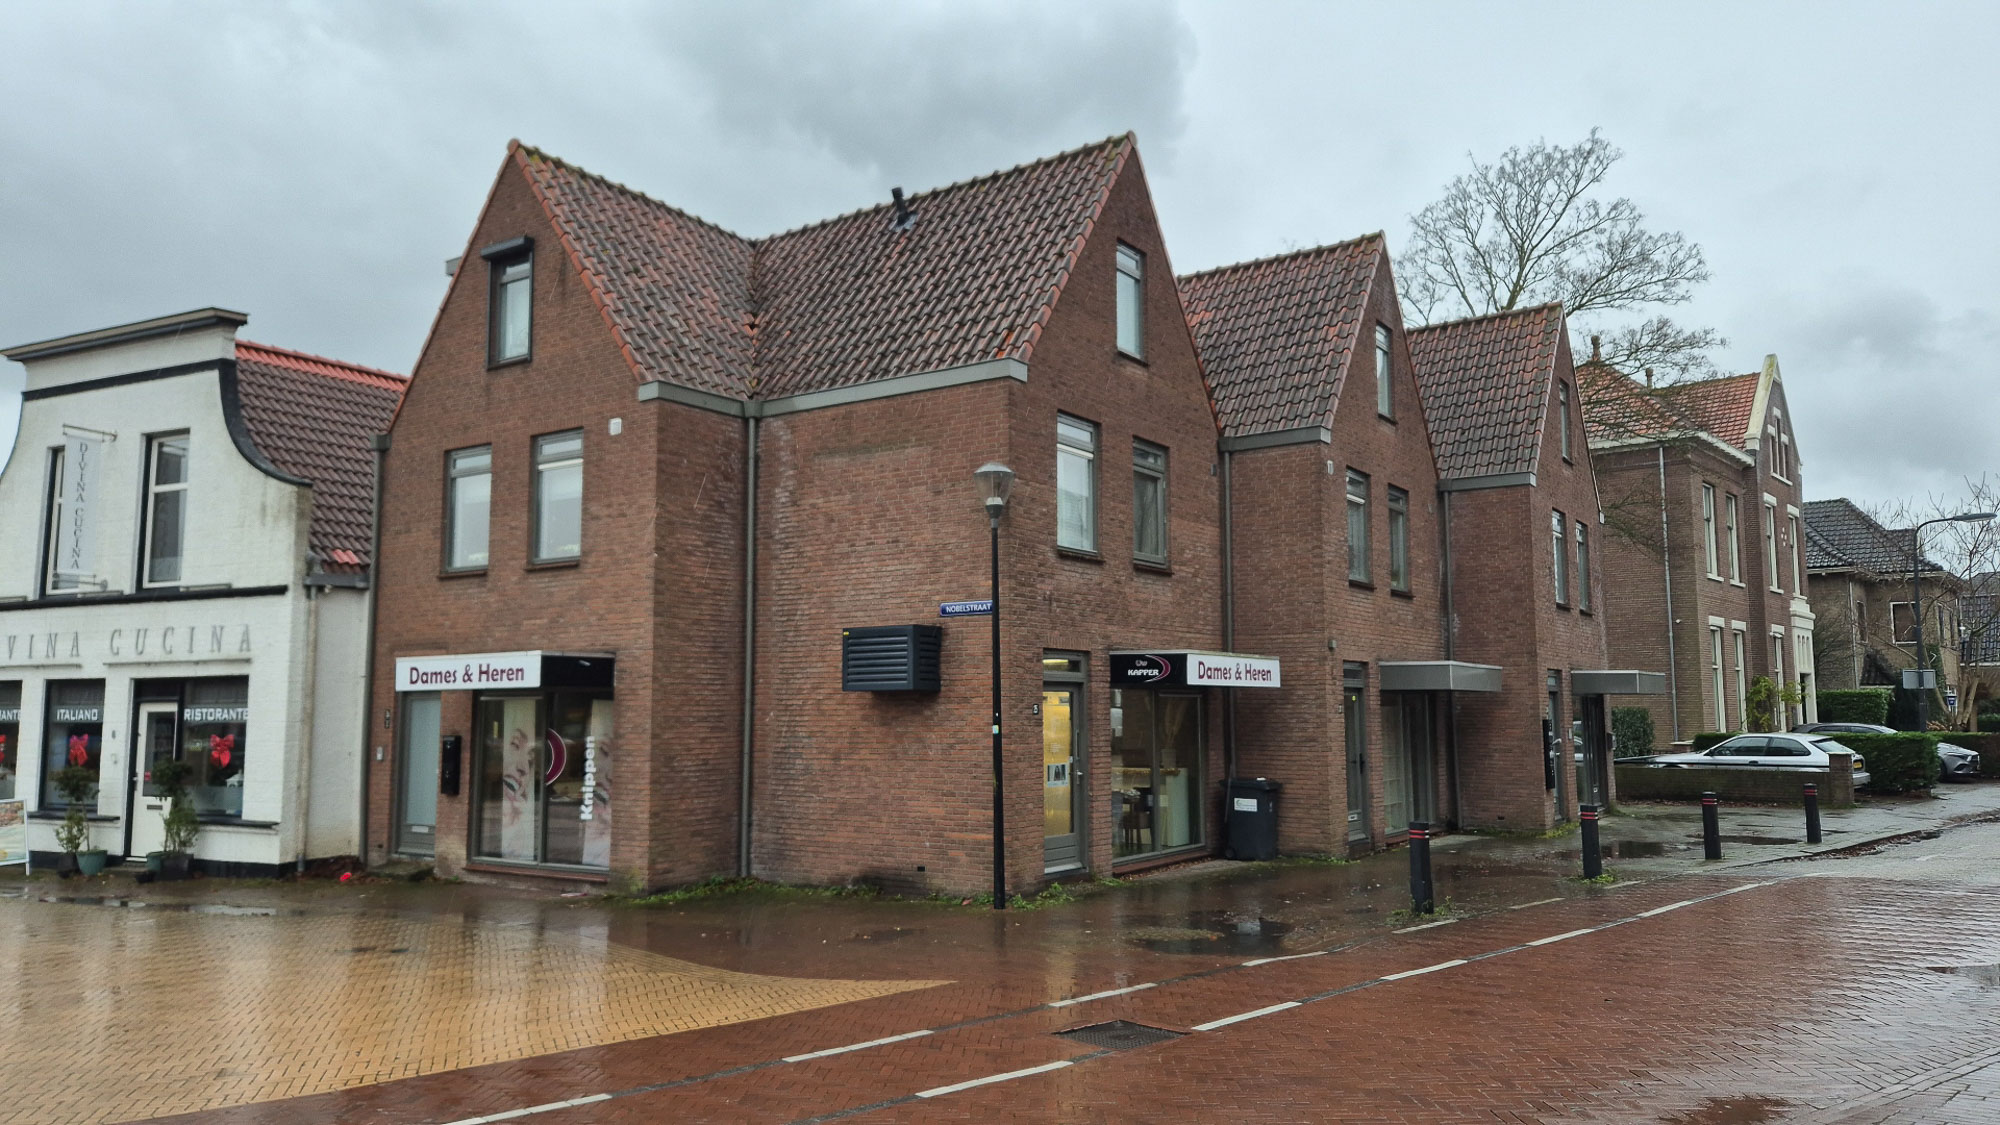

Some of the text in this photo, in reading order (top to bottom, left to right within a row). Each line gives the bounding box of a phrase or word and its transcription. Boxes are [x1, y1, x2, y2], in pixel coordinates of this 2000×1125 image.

[71, 442, 88, 569] DIVINA CUCINA
[946, 603, 992, 613] NOBELSTRAAT
[7, 624, 252, 660] VINA CUCINA
[409, 663, 525, 685] Dames & Heren
[1198, 661, 1272, 681] Dames & Heren
[56, 708, 98, 721] ITALIANO
[184, 707, 248, 721] RISTORANTE
[580, 736, 597, 820] Knippen
